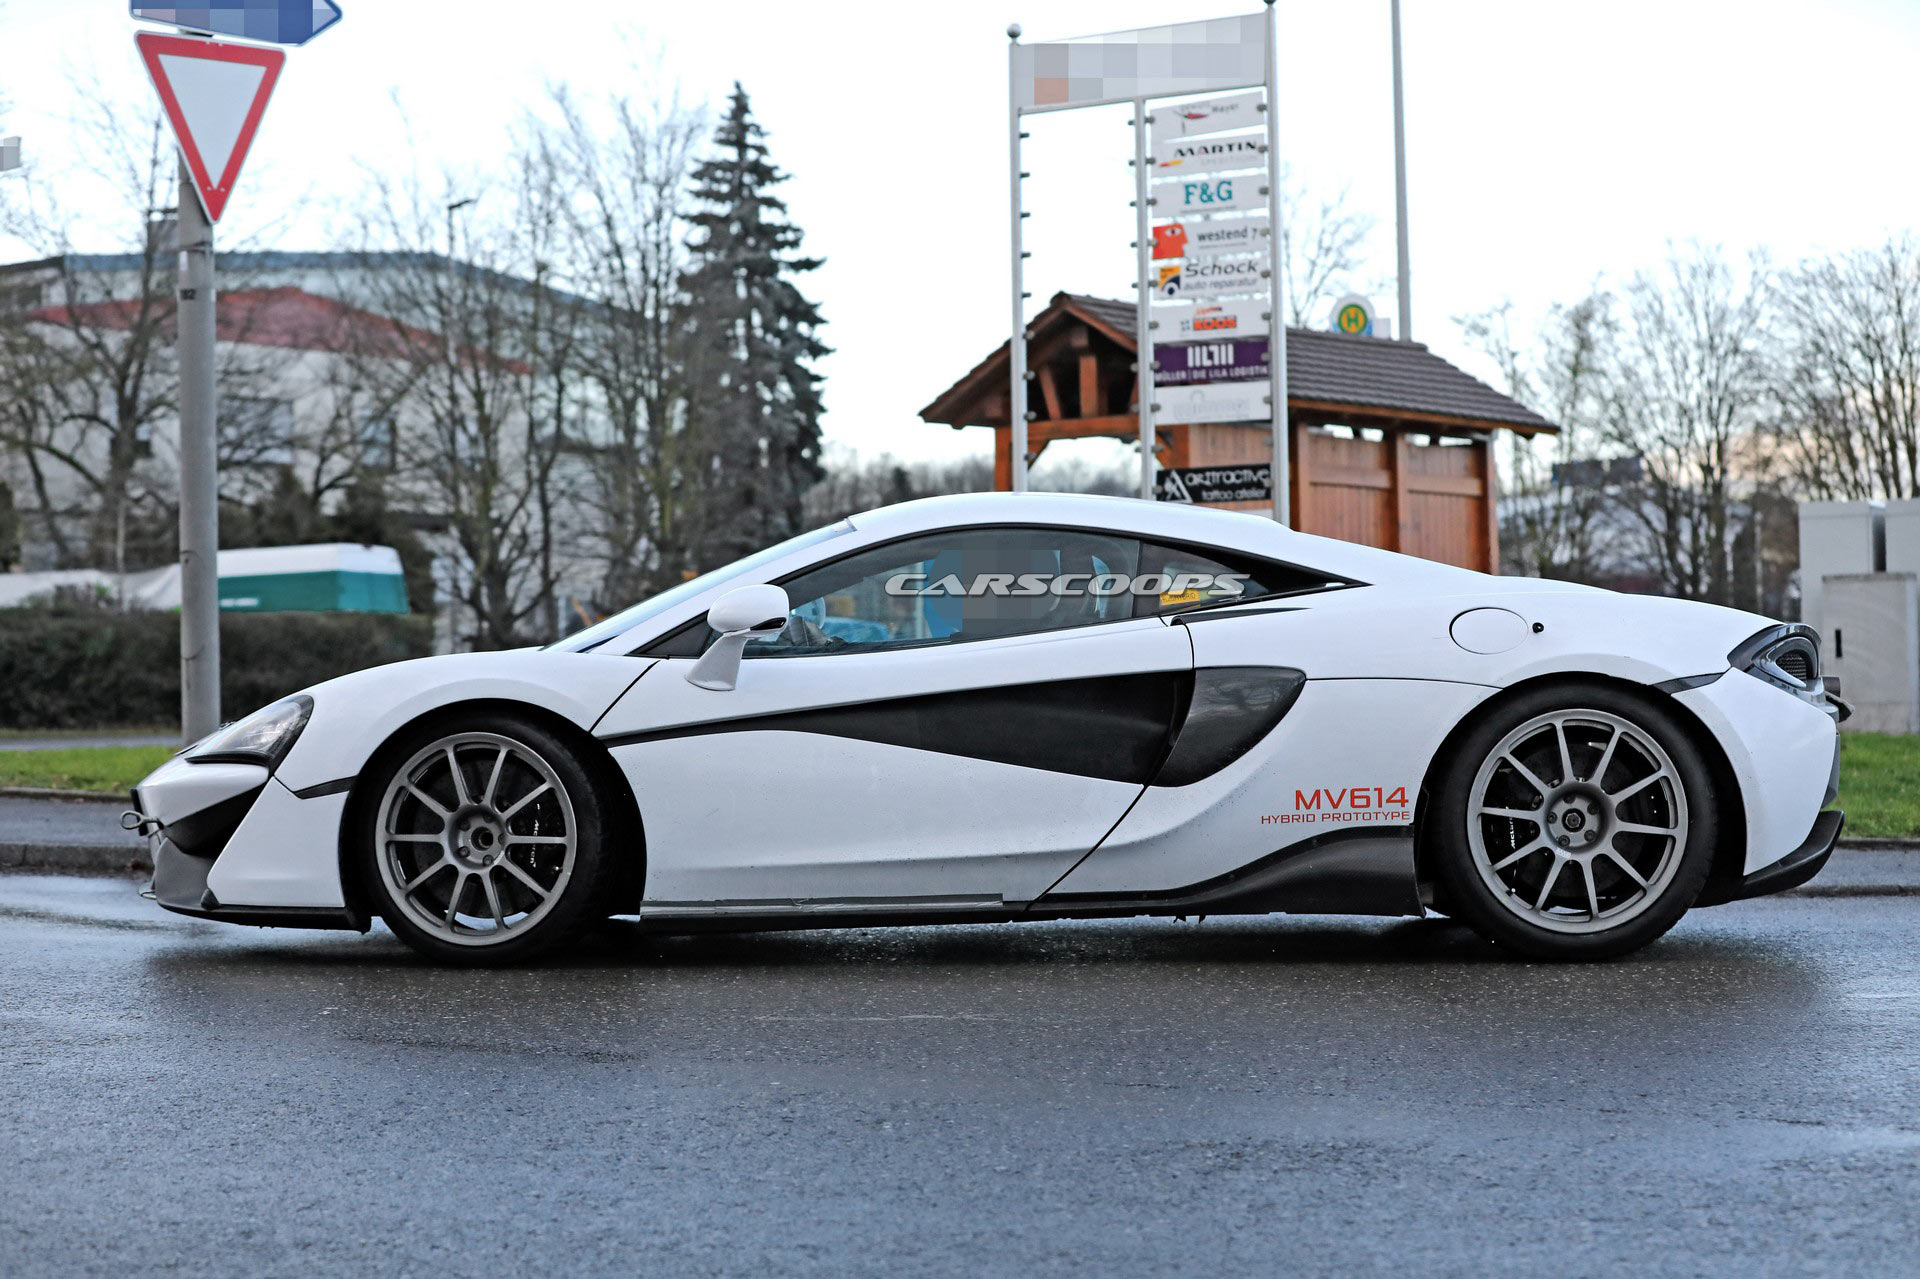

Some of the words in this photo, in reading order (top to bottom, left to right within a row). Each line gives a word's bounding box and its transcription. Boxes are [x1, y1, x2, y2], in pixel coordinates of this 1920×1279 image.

[1174, 141, 1257, 157] MARTIN
[1184, 180, 1233, 205] F&G
[1198, 226, 1248, 241] westend
[1184, 259, 1258, 278] Schock
[1346, 311, 1360, 328] H
[1193, 368, 1207, 380] DIE
[1209, 367, 1228, 379] LILA
[1295, 786, 1410, 811] MV614
[1261, 813, 1316, 824] HYBRID
[1321, 811, 1411, 823] PROTOTYPE
